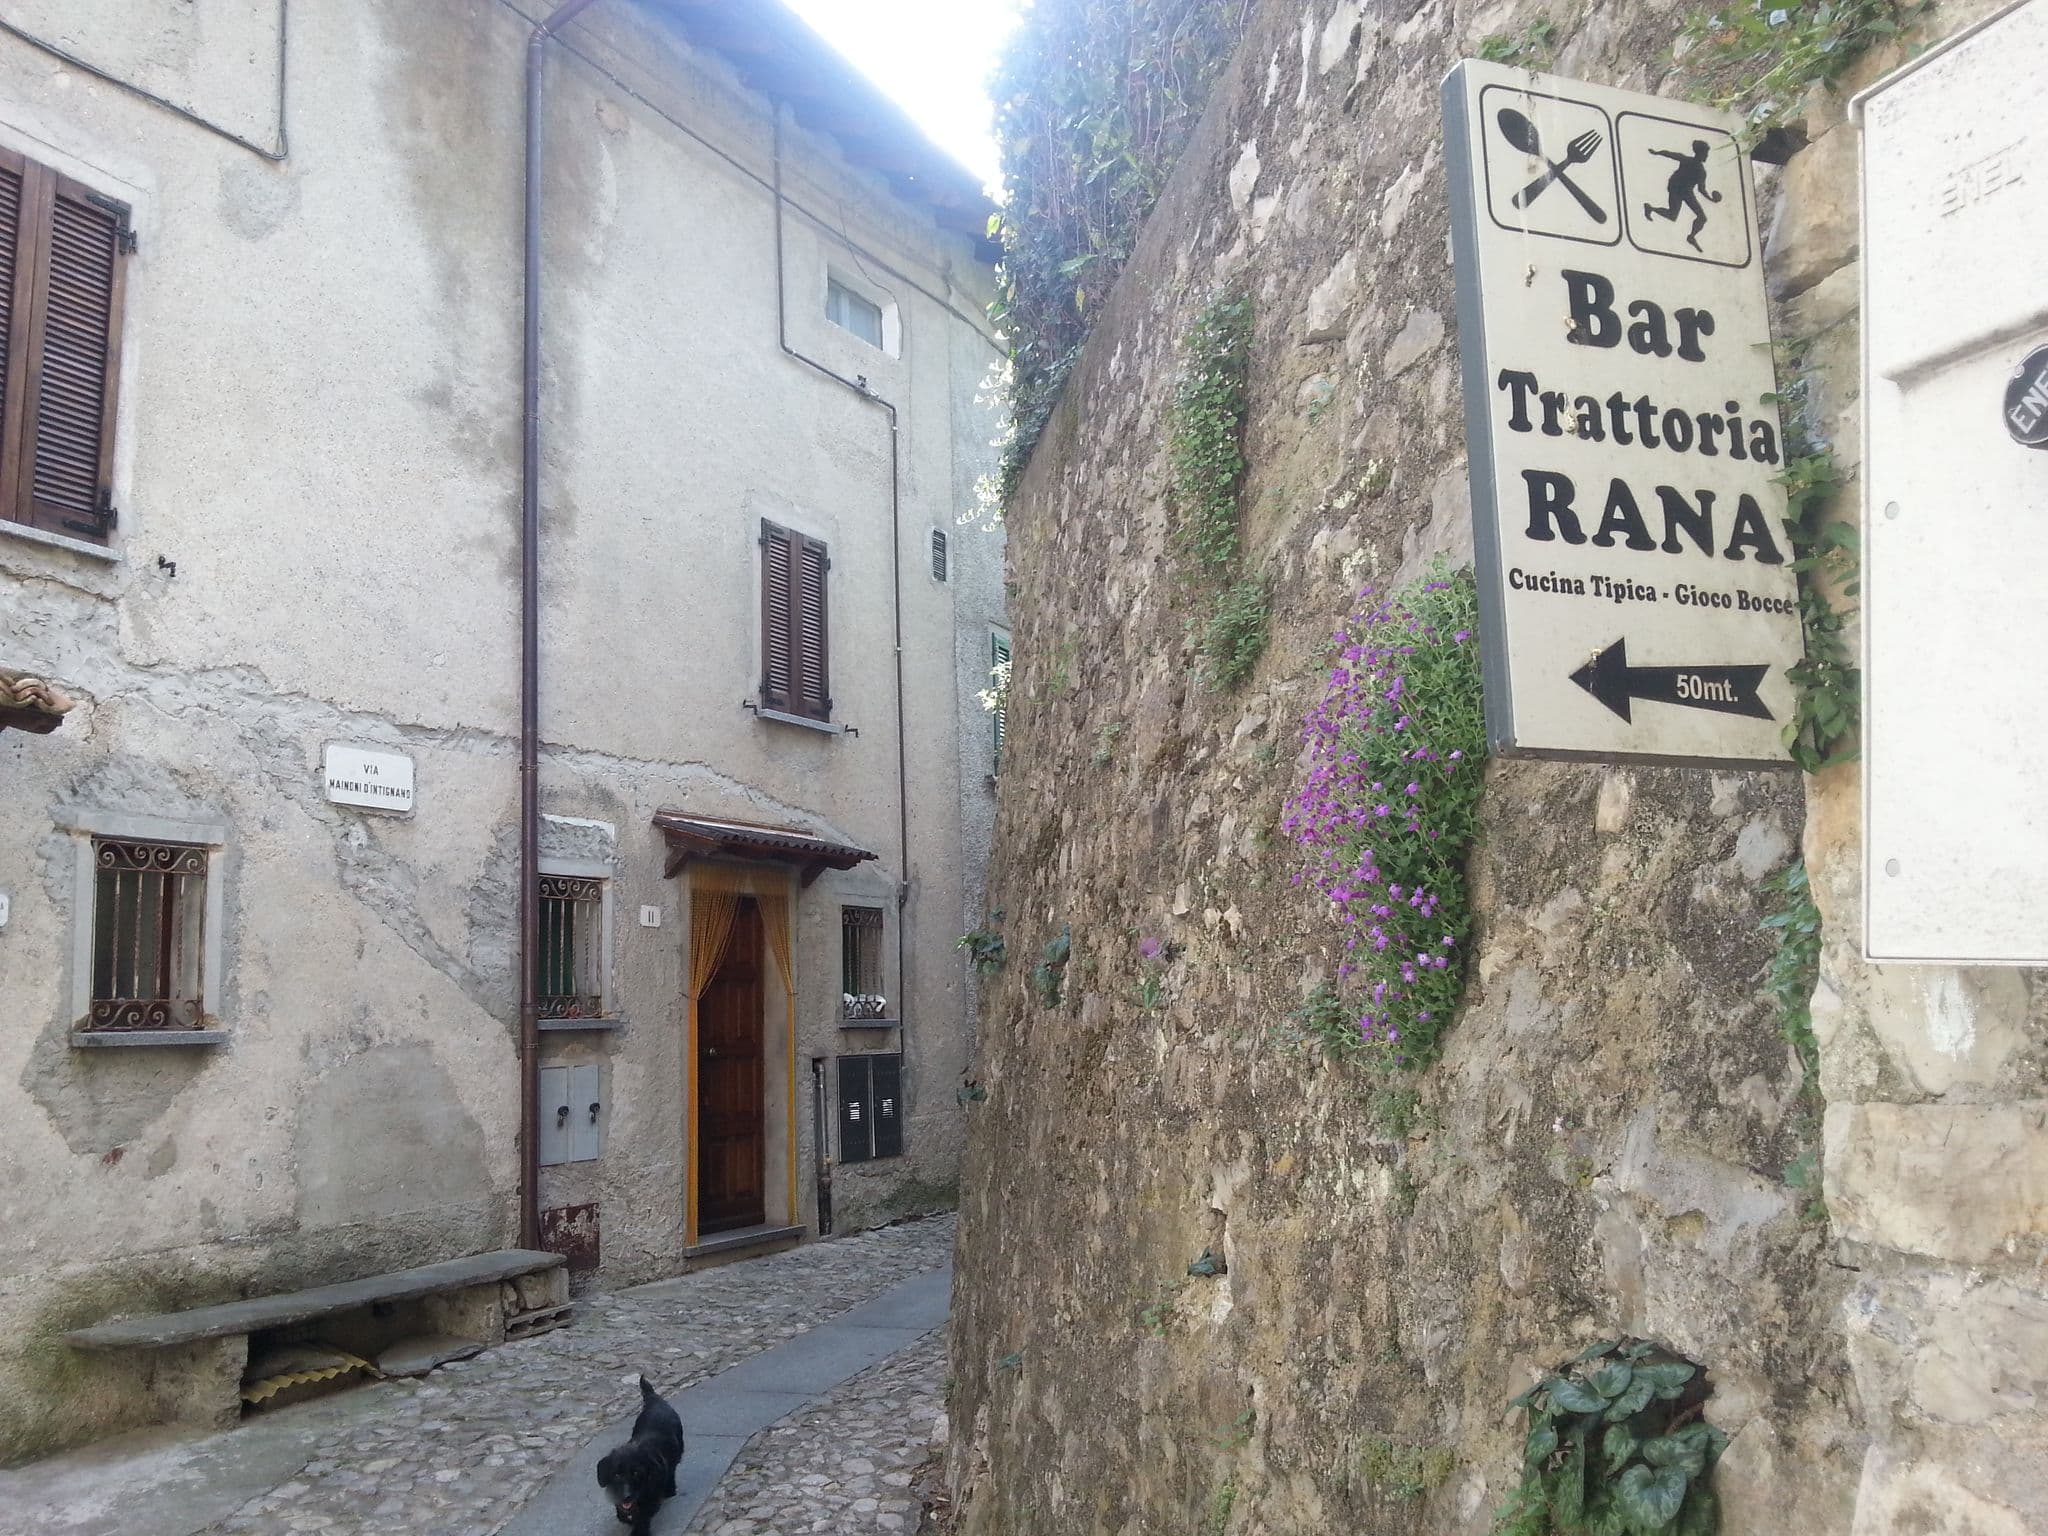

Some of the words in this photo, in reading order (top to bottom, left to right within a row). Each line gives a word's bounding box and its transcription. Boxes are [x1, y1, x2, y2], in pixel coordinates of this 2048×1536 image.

[1940, 153, 2024, 217] ENEL
[1561, 268, 1715, 363] Bar
[1497, 368, 1780, 465] Trattoria
[2010, 361, 2048, 434] ENE
[1520, 468, 1785, 566] RANA
[1508, 567, 1585, 597] Cucina
[1590, 574, 1657, 604] Tipica
[1675, 583, 1732, 610] Gioco
[1737, 589, 1794, 616] Bocce
[1675, 673, 1740, 704] 50mt.
[329, 779, 362, 793] MAINONI
[363, 782, 411, 799] D'INTIGNANO
[363, 764, 379, 776] VIA
